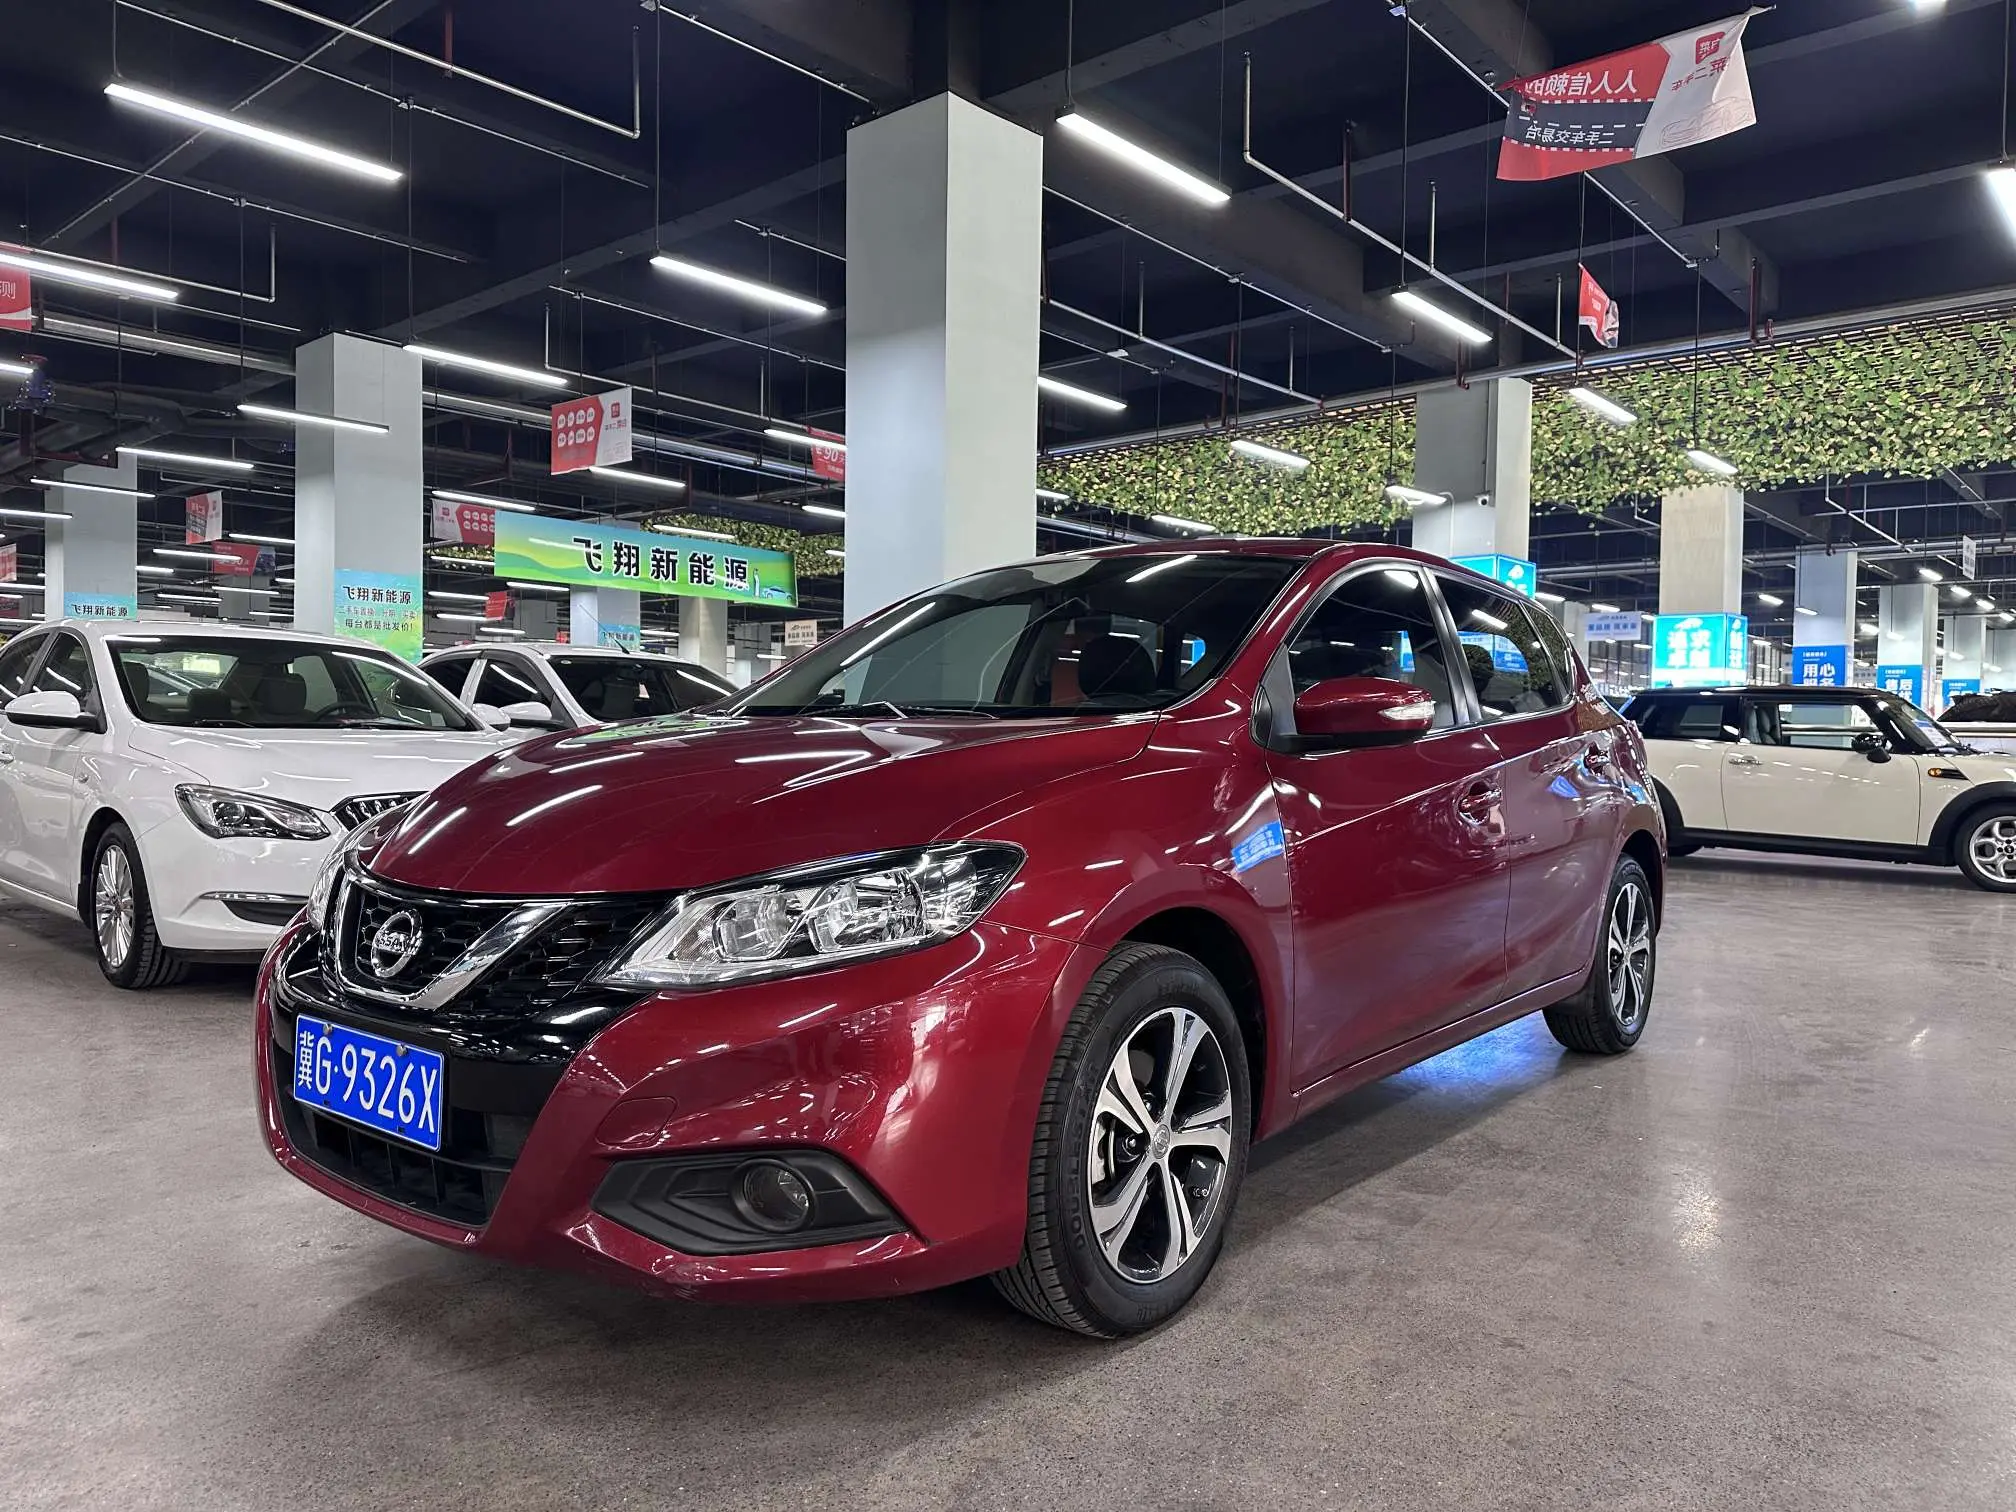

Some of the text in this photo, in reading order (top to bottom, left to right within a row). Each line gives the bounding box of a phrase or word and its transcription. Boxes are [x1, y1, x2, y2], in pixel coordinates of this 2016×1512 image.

[0, 281, 17, 300] 则
[573, 537, 748, 589] 飞翔新能源
[342, 585, 412, 605] 飞翔新能源
[72, 604, 128, 617] 飞翔新能源
[1803, 662, 1836, 678] 用心
[298, 1031, 438, 1133] 冀G·9326X
